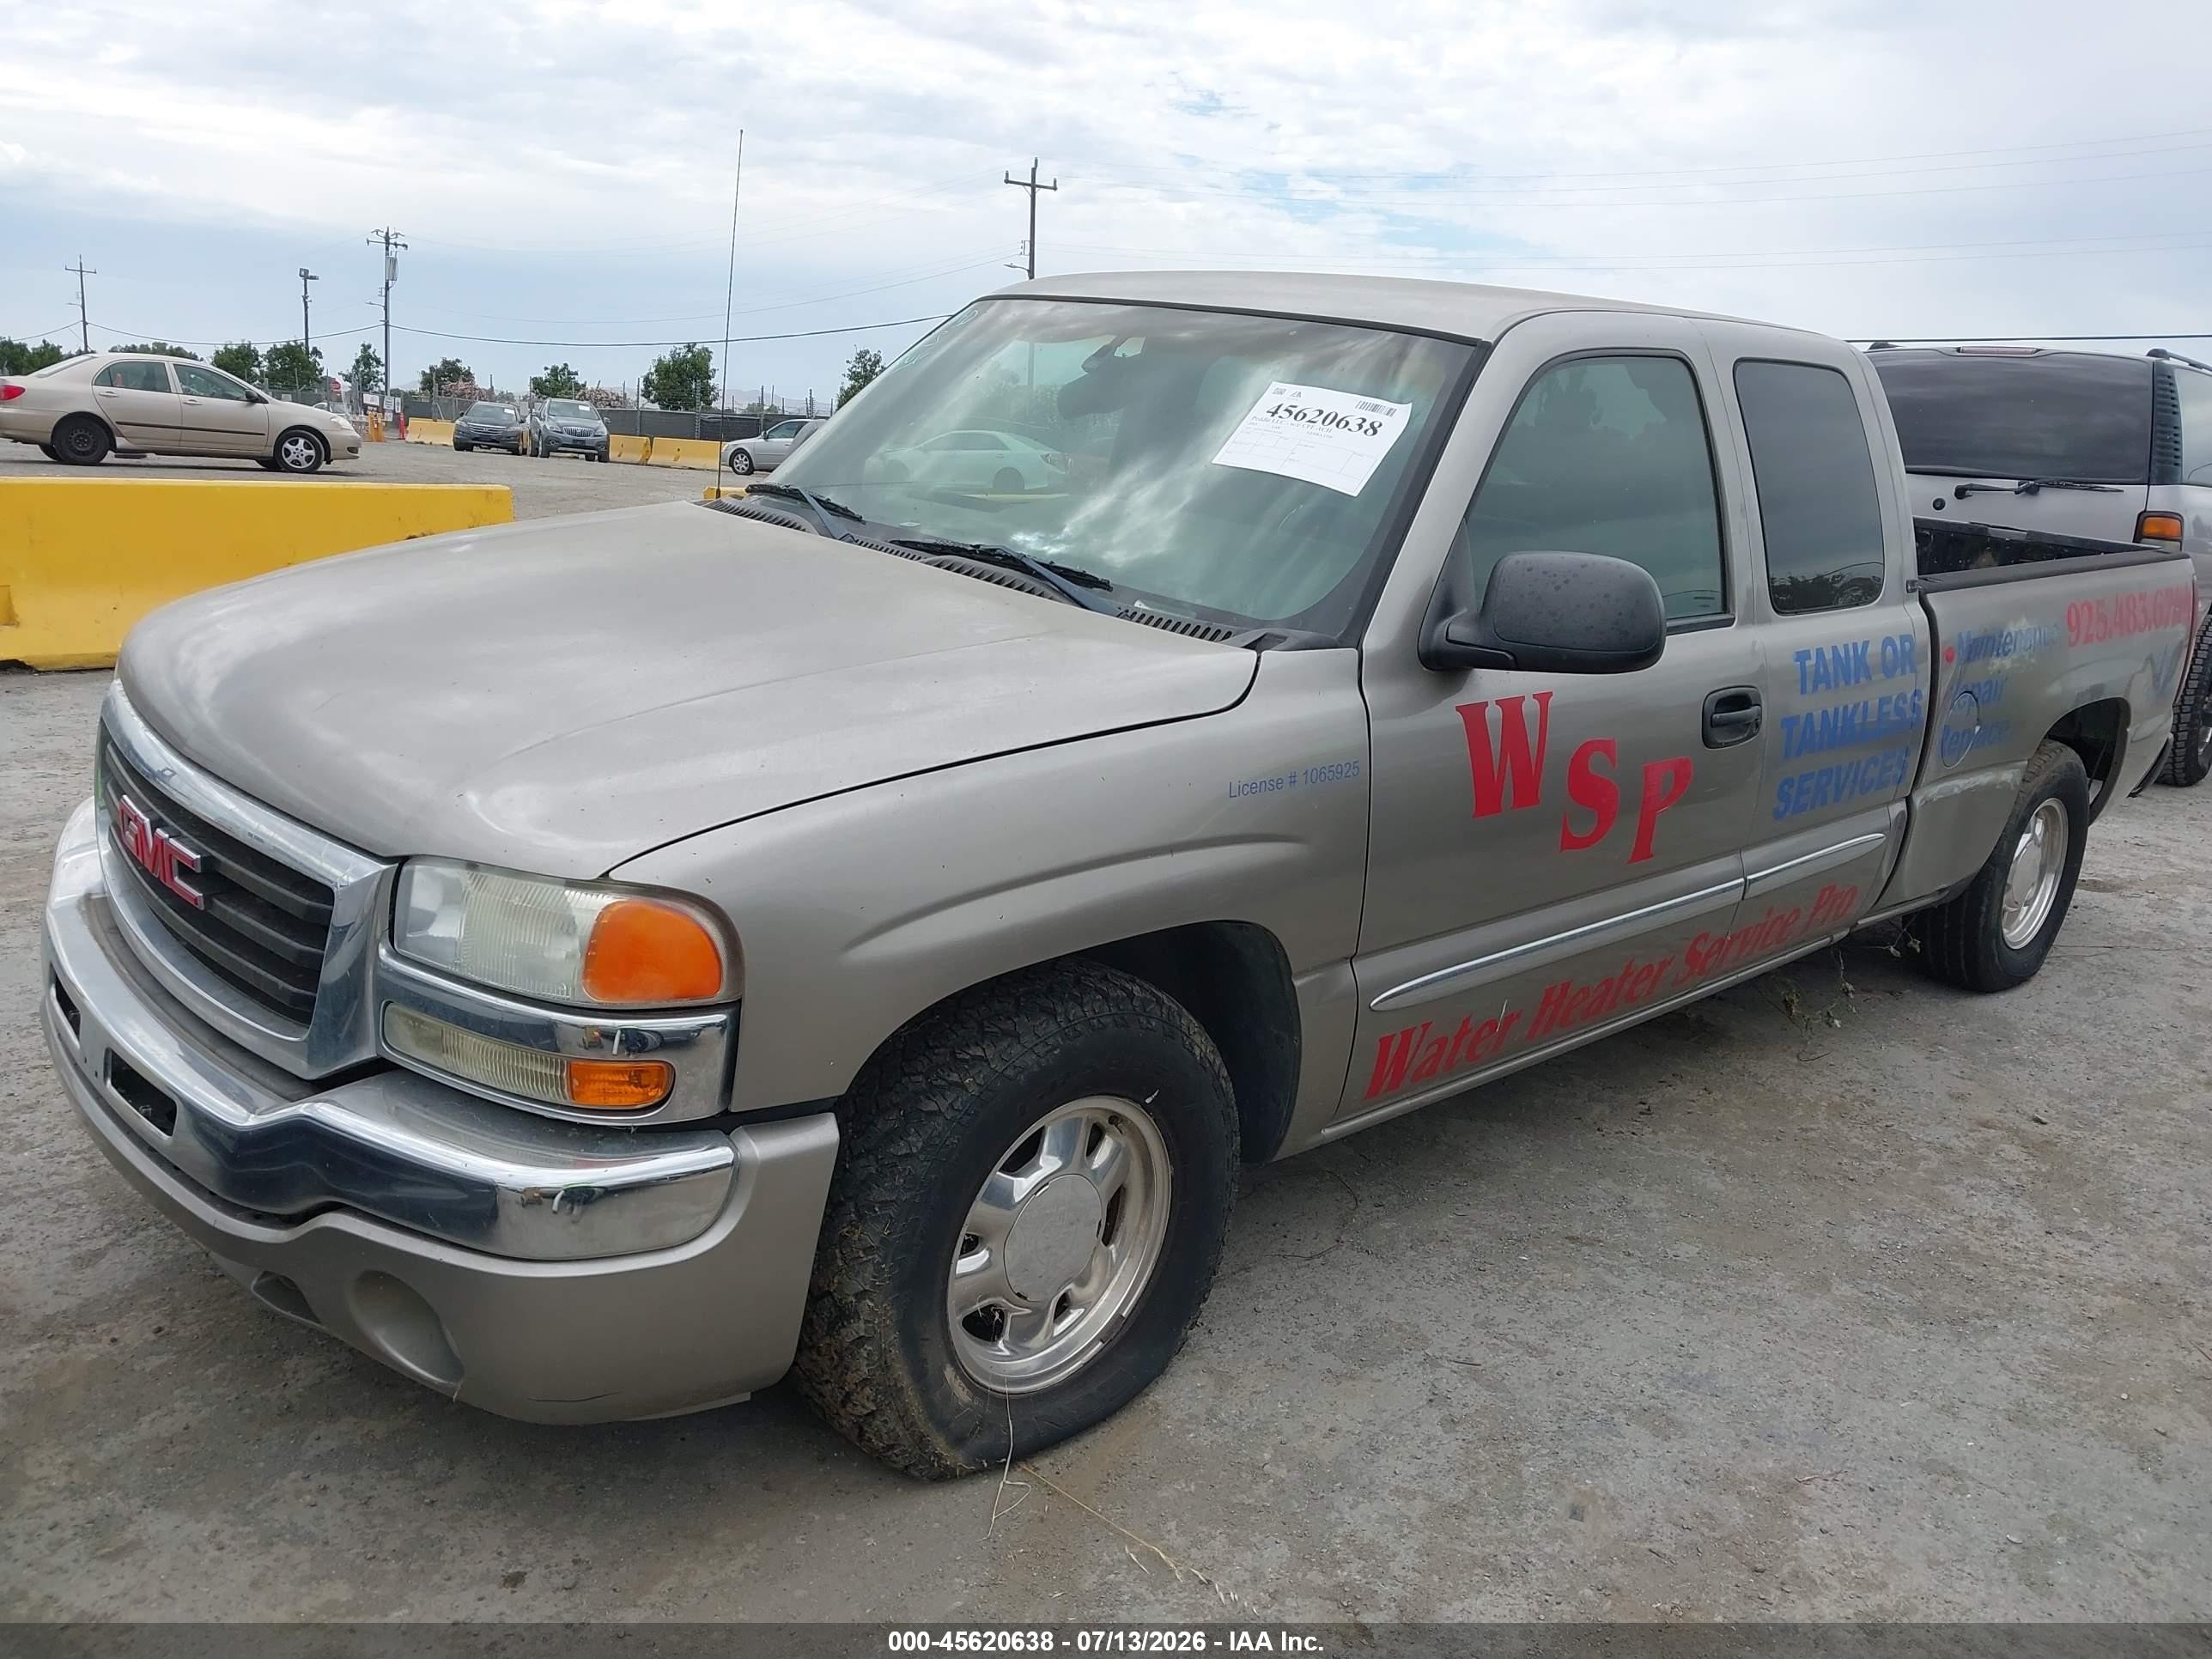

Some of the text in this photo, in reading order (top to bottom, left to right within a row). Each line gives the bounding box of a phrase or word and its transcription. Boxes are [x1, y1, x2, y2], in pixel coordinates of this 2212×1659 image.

[1266, 403, 1382, 437] 45620638
[1794, 634, 1917, 695] TANK OR
[1780, 689, 1924, 761] TANKLESS
[1229, 761, 1361, 799] License # 1065925
[1772, 745, 1910, 822] SERVICES
[118, 794, 205, 911] GMC
[1363, 884, 1858, 1102] Water Heater Service Pro
